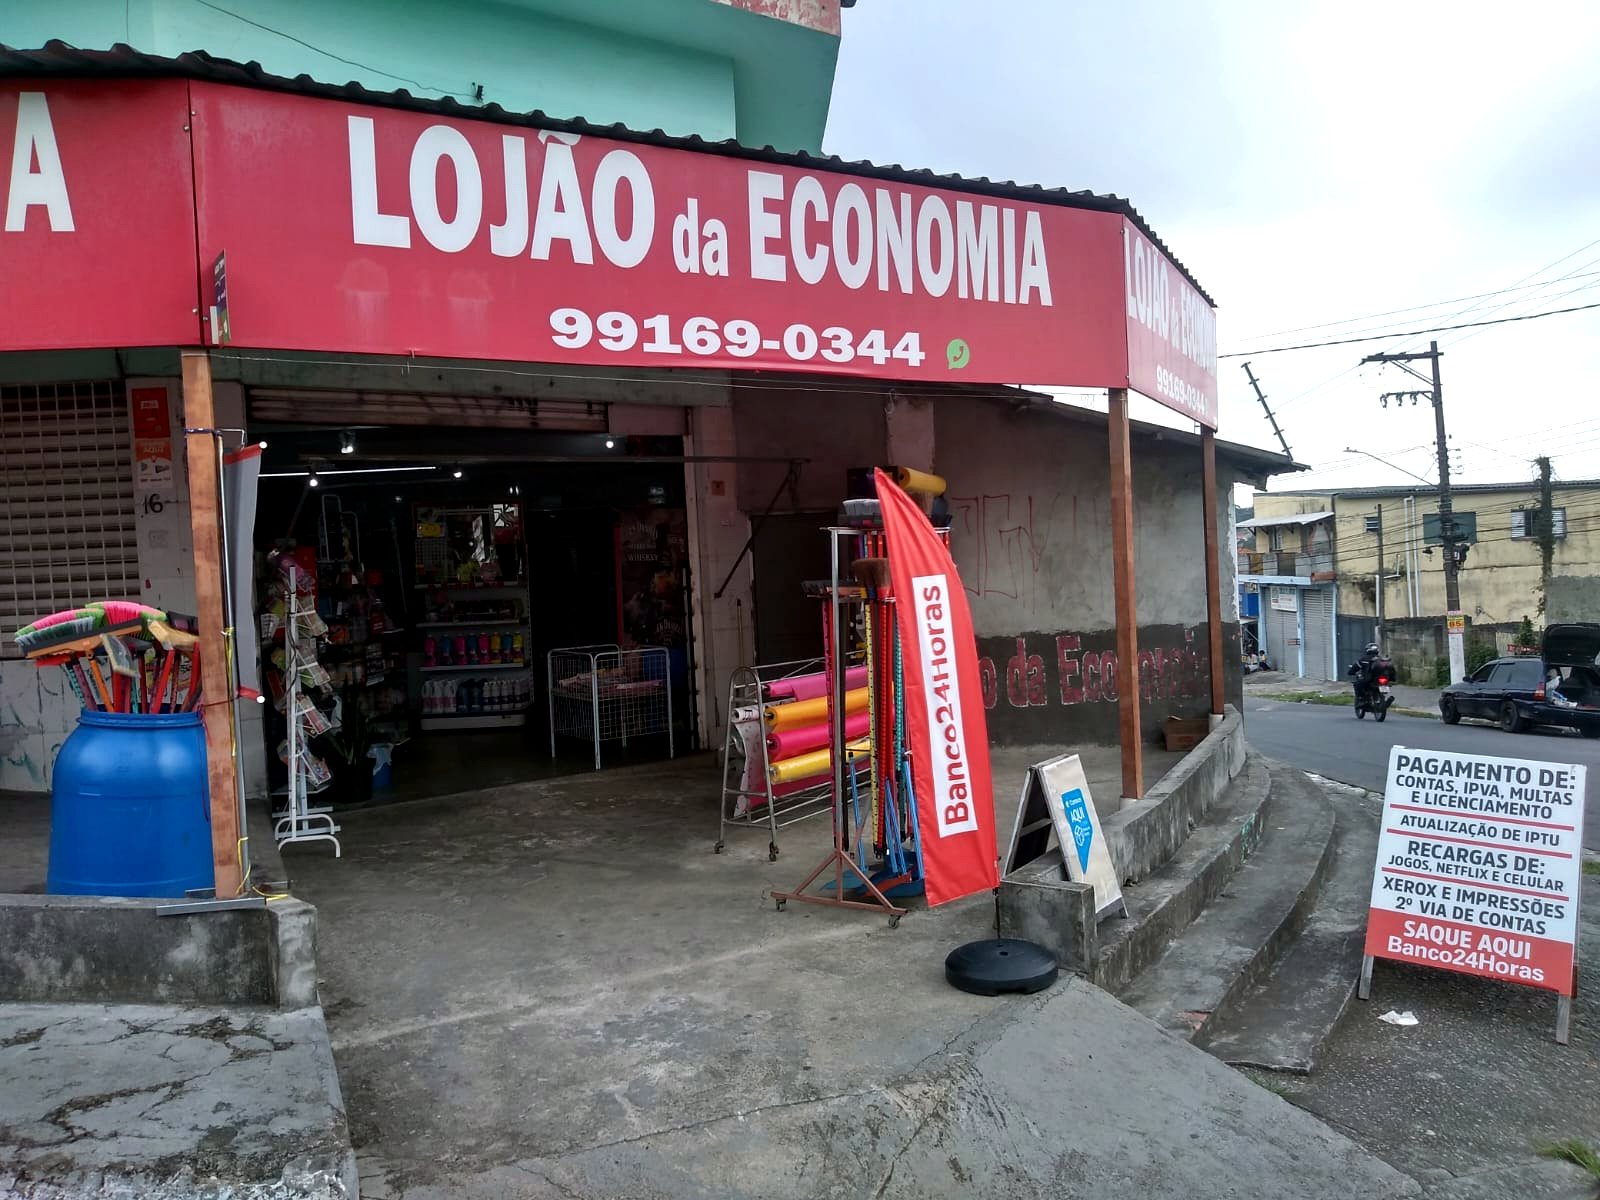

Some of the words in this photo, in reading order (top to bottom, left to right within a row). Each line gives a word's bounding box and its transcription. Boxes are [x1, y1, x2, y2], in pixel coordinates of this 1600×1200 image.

[347, 115, 655, 269] LOJÃO
[672, 197, 729, 277] da
[748, 169, 1053, 307] ECONOMIA
[549, 308, 926, 367] 99169-0344
[1006, 637, 1048, 708] da
[923, 585, 969, 826] Banco24Horas
[1396, 754, 1531, 785] PAGAMENTO
[1539, 768, 1576, 790] DE:
[1396, 774, 1458, 794] CONTAS,
[1463, 782, 1504, 799] IPVA,
[1510, 787, 1573, 806] MULTAS
[1411, 791, 1420, 803] E
[1425, 793, 1552, 819] LICENCIAMENTO
[1400, 814, 1497, 838] ATUALIZAÇÃO
[1502, 828, 1520, 841] DE
[1525, 831, 1560, 846] IPTU
[1388, 855, 1432, 873] JOGOS,
[1436, 863, 1488, 880] NETFLIX
[1492, 871, 1500, 882] E
[1504, 873, 1564, 892] CELULAR
[1408, 840, 1508, 869] RECARGAS
[1514, 856, 1545, 875] DE:
[1383, 876, 1437, 898] XEROX
[1442, 887, 1451, 900] E
[1456, 889, 1565, 920] IMPRESSÕES
[1420, 900, 1447, 918] VIA
[1452, 906, 1474, 922] DE
[1479, 911, 1546, 935] CONTAS
[1388, 936, 1545, 982] Banco24Horas
[1403, 920, 1472, 949] SAQUE
[1478, 935, 1531, 961] AQUI
